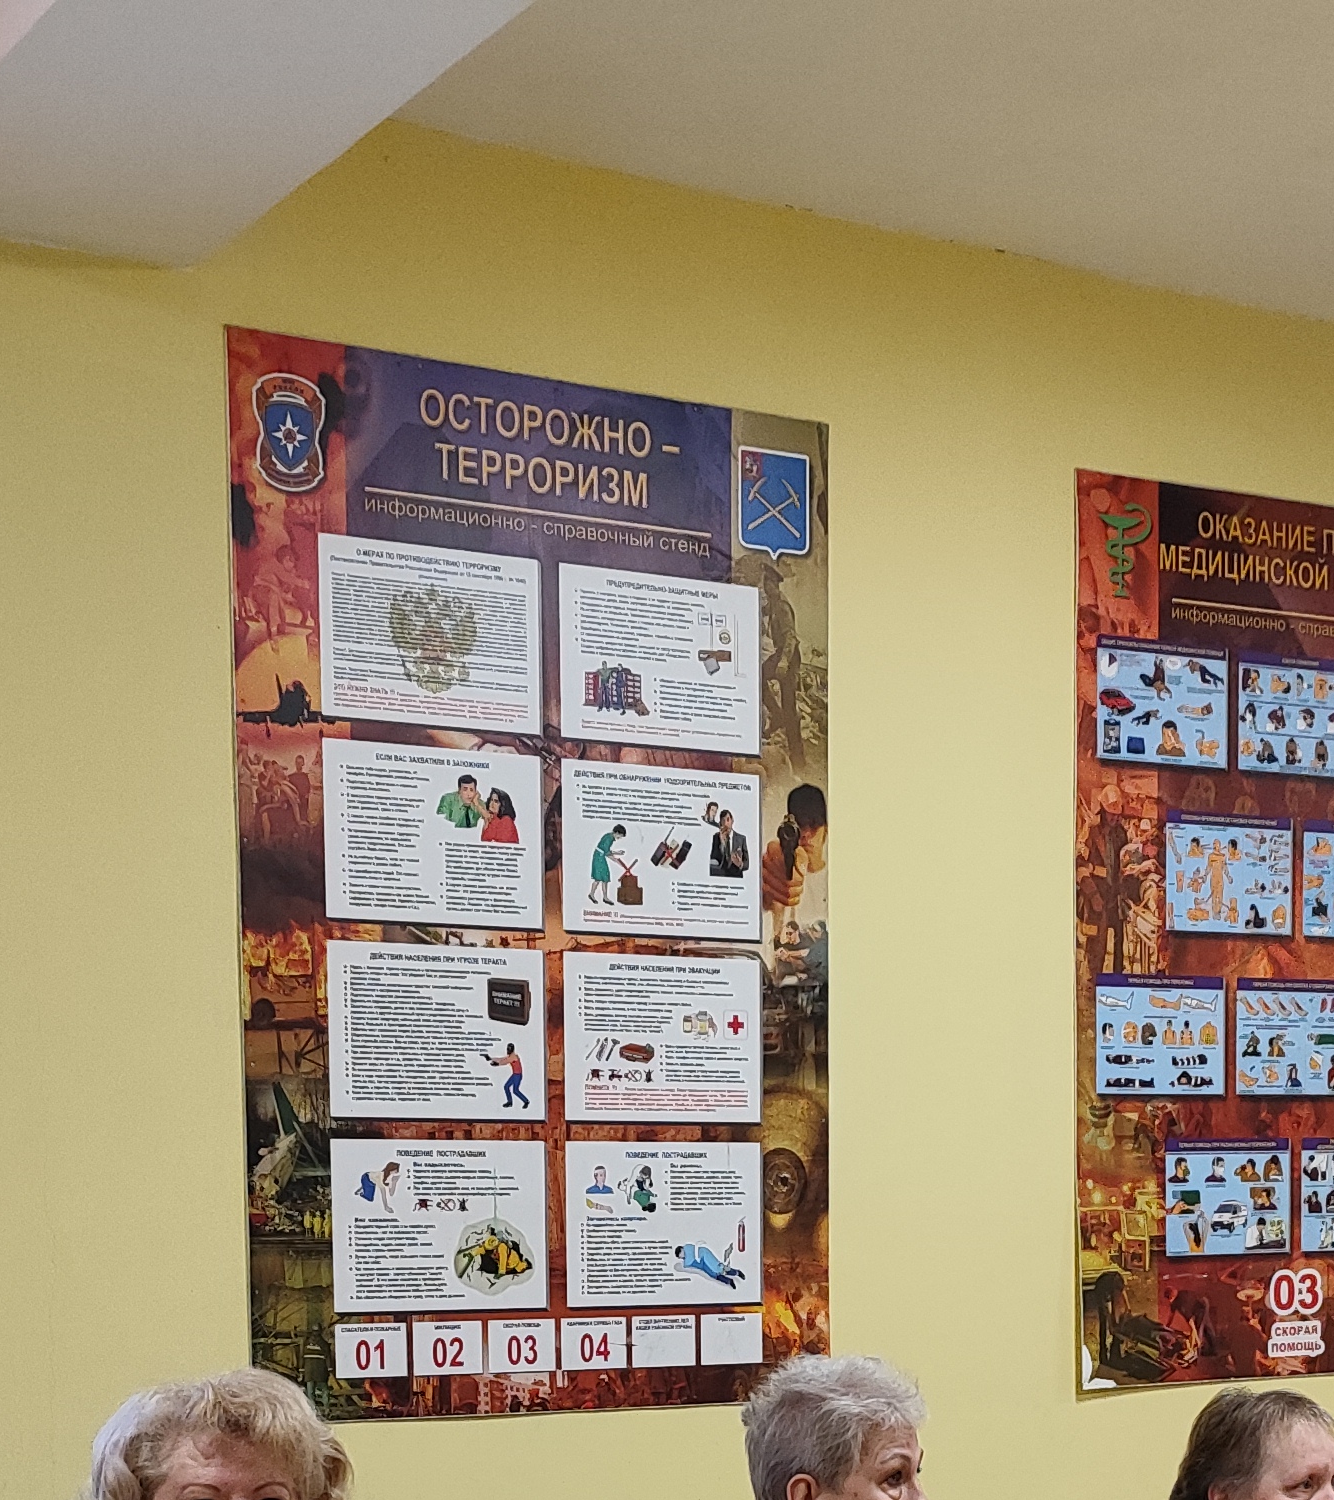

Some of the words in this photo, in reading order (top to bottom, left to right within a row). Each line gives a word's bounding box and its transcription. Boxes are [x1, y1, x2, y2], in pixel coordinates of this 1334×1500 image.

[420, 389, 652, 459] ОСТОРОЖНО
[434, 442, 650, 509] ТЕРРОРИЗМ
[364, 498, 526, 533] информационно
[543, 520, 655, 549] справочный
[659, 535, 711, 559] стенд
[1197, 510, 1316, 553] ОКАЗАНИЕ
[1158, 543, 1332, 591] МЕДИЦИНСКОЙ
[1170, 606, 1287, 633] информационно
[1273, 1273, 1320, 1312] 03
[1274, 1324, 1319, 1337] СКОРАЯ
[355, 1339, 385, 1371] 01
[432, 1337, 465, 1368] 02
[507, 1334, 538, 1366] 03
[580, 1332, 611, 1363] 04
[1270, 1340, 1322, 1354] ПОМОЩЬ
